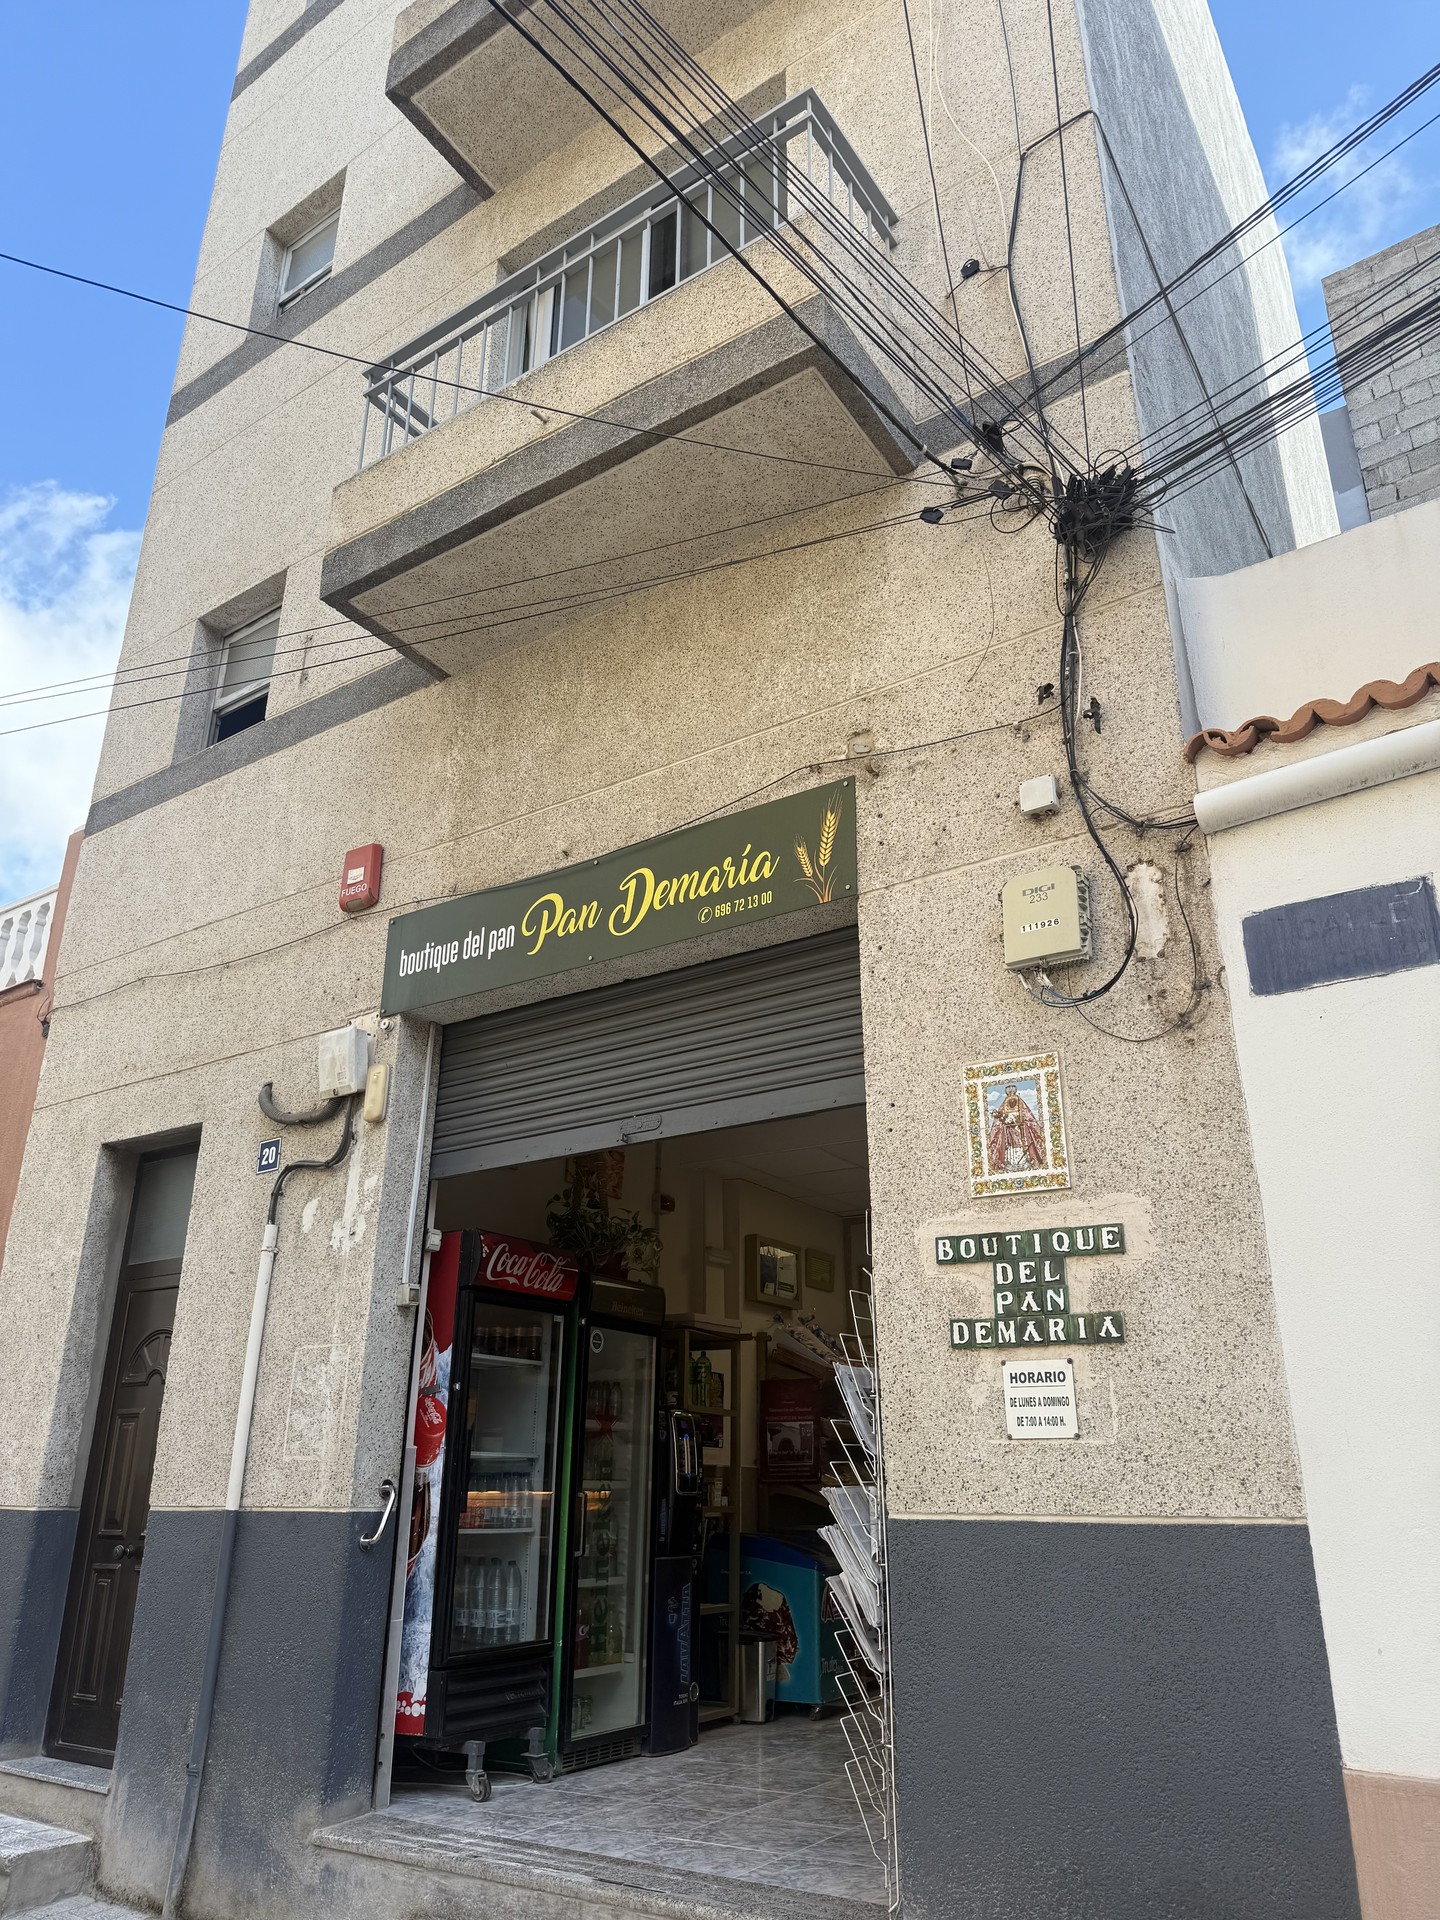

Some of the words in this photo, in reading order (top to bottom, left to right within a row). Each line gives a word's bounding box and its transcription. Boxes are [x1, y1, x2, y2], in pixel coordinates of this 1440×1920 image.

[341, 883, 368, 898] FUEGO
[1022, 883, 1056, 898] DIGI
[1029, 892, 1049, 904] 233
[399, 941, 459, 977] boutique
[463, 927, 485, 960] del
[488, 925, 516, 960] pan
[521, 893, 602, 955] Pan
[608, 844, 780, 937] Demaría
[715, 902, 731, 918] 696
[734, 899, 745, 912] 72
[748, 895, 758, 909] 13
[761, 891, 773, 905] 00
[1022, 918, 1060, 932] 111926
[261, 1146, 276, 1166] 20
[938, 1226, 1120, 1261] BOUTIQUE
[996, 1260, 1060, 1285] DEL
[997, 1289, 1065, 1314] PAN
[953, 1315, 1121, 1345] DEMARIA
[1010, 1371, 1067, 1384] HORARIO
[1010, 1397, 1017, 1408] DE
[1018, 1397, 1036, 1408] LUNES
[1038, 1397, 1042, 1407] A
[1043, 1396, 1070, 1408] DOMINGO
[1017, 1416, 1024, 1427] DE
[1025, 1416, 1037, 1427] 7:00
[1038, 1416, 1043, 1427] A
[1044, 1416, 1058, 1427] 14:00
[1060, 1416, 1066, 1427] H.
